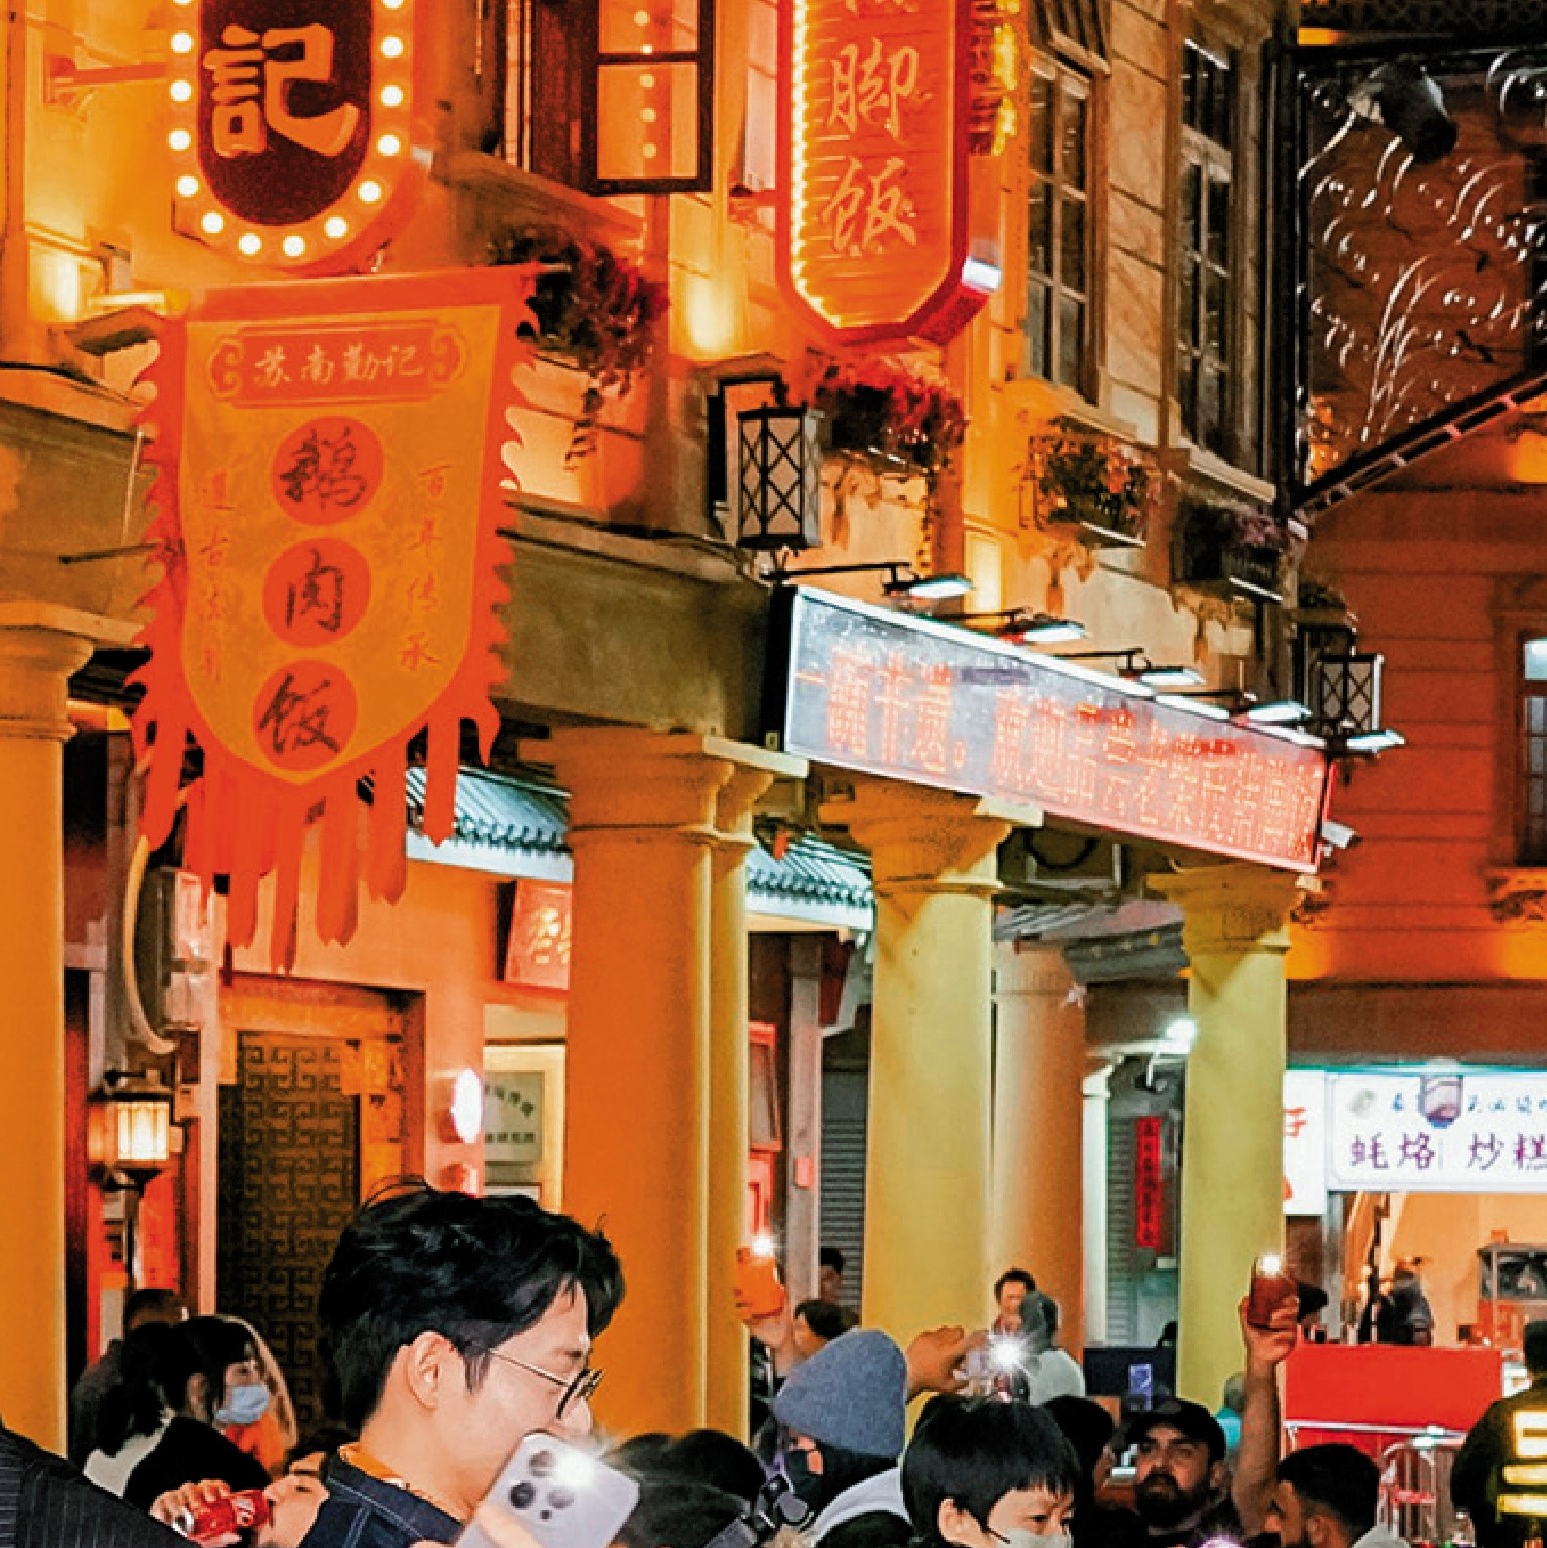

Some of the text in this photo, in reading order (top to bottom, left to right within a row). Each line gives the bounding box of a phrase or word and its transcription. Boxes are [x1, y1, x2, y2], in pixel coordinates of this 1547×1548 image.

[822, 0, 933, 257] 脚饭
[254, 343, 426, 389] 苏南勤记
